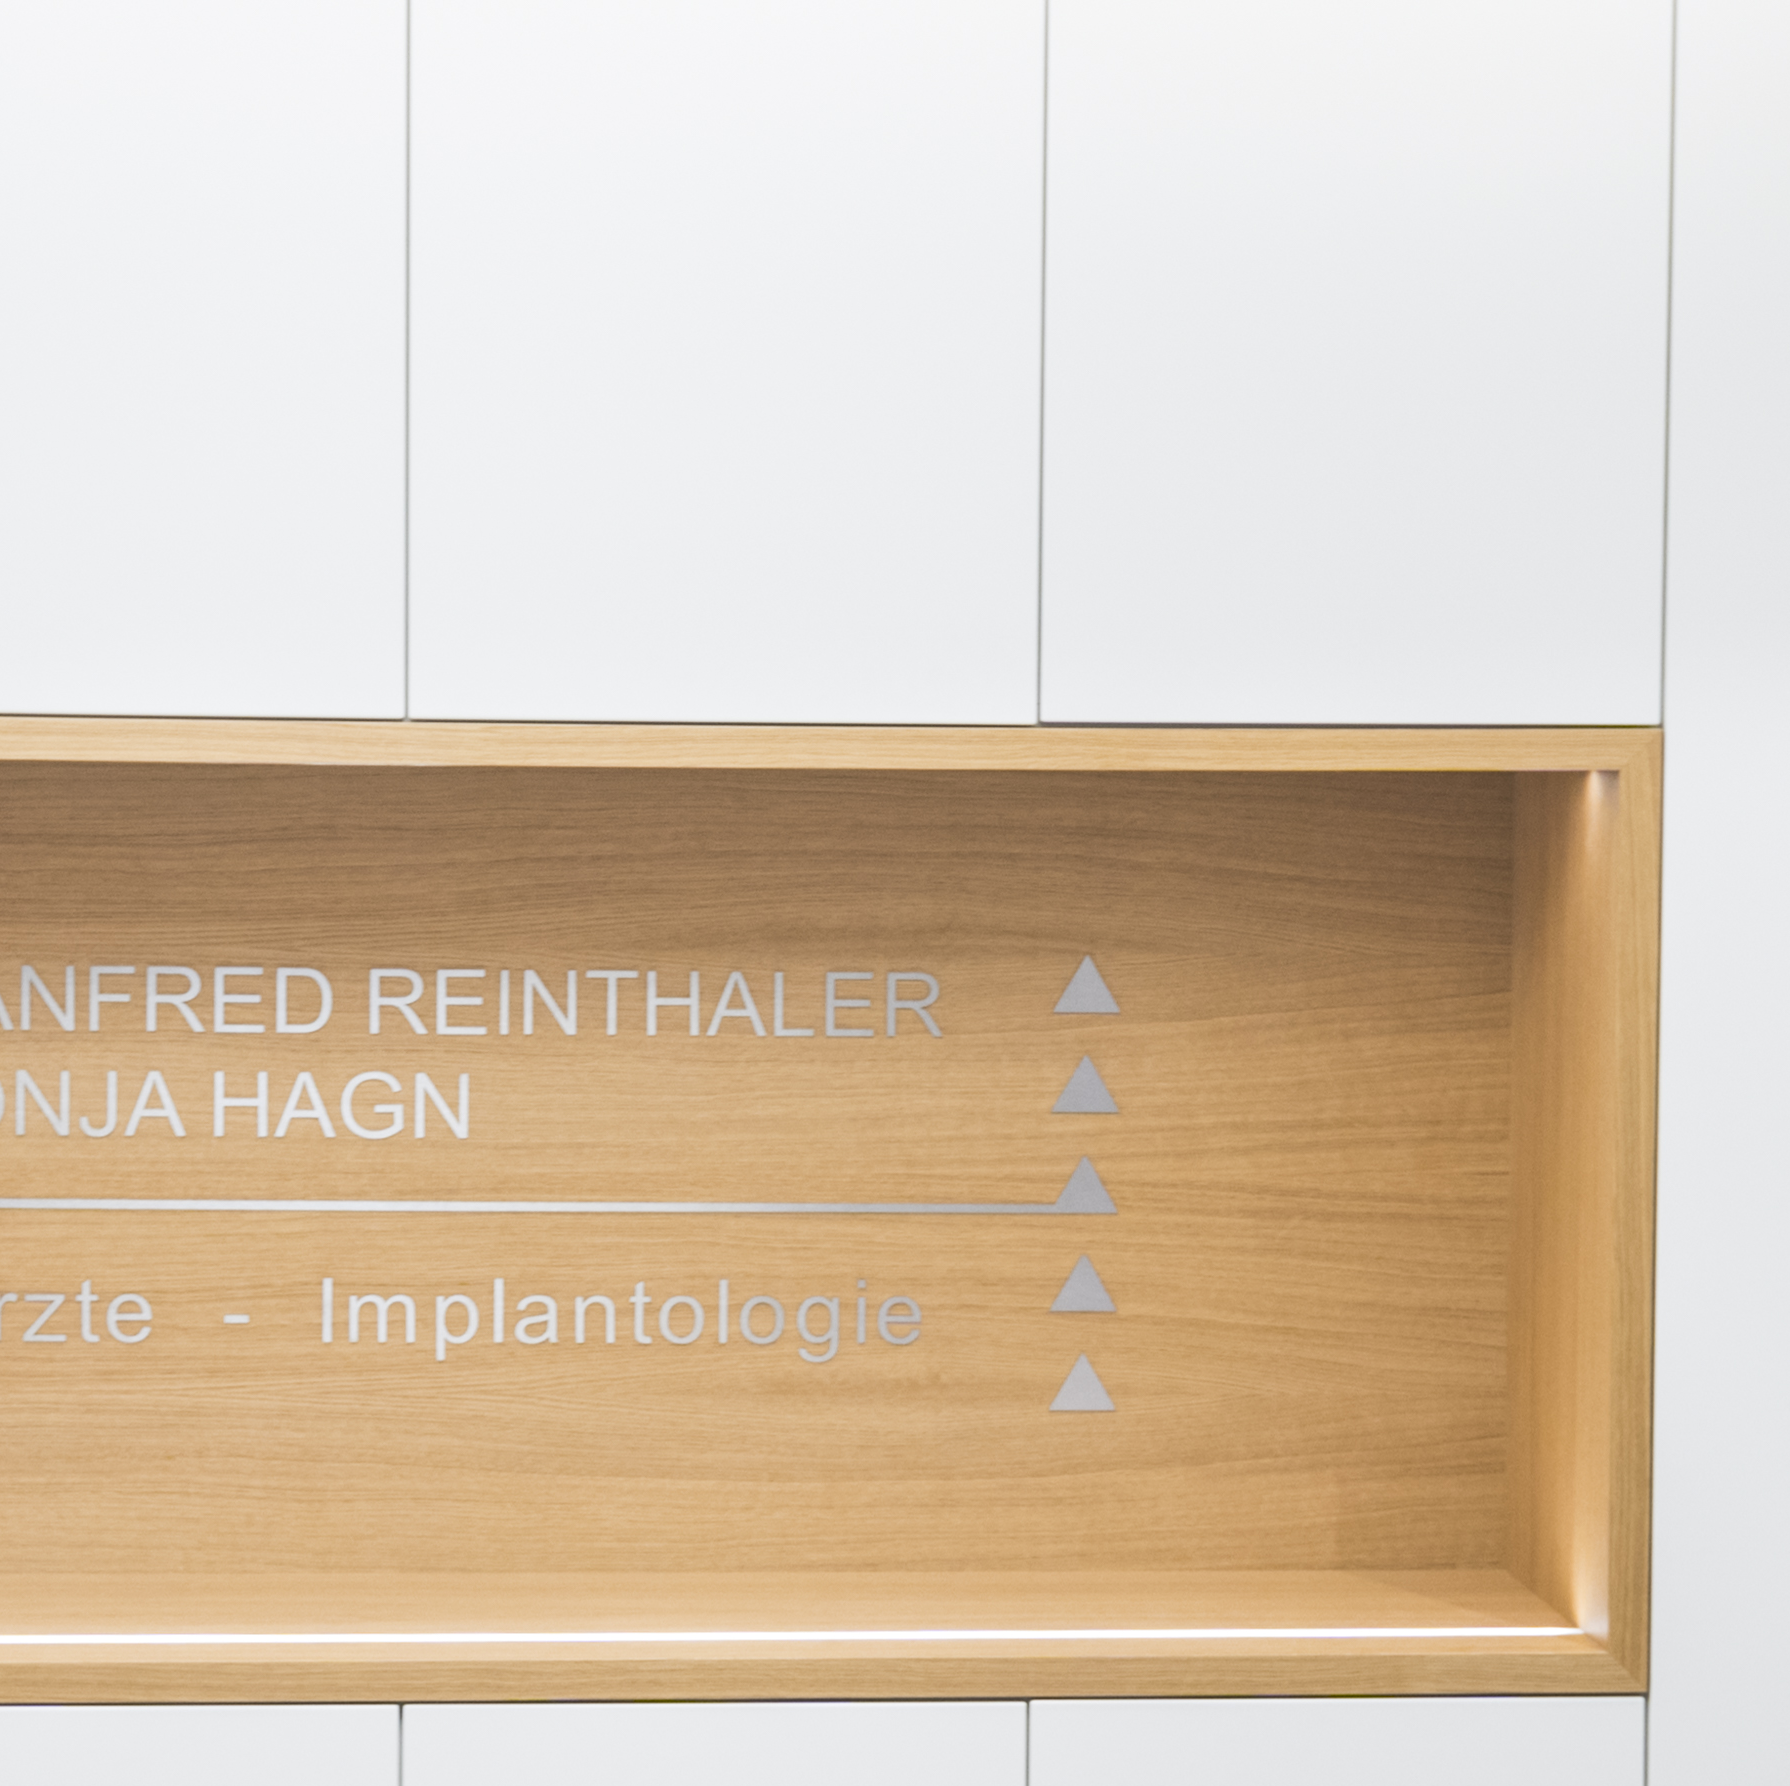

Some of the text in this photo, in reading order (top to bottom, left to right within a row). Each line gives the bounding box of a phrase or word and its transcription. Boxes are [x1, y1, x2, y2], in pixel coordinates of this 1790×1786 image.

[368, 967, 944, 1038] REINTHALER
[212, 1070, 470, 1139] HAGN
[222, 1313, 251, 1325] -
[321, 1277, 923, 1363] Implantologie
